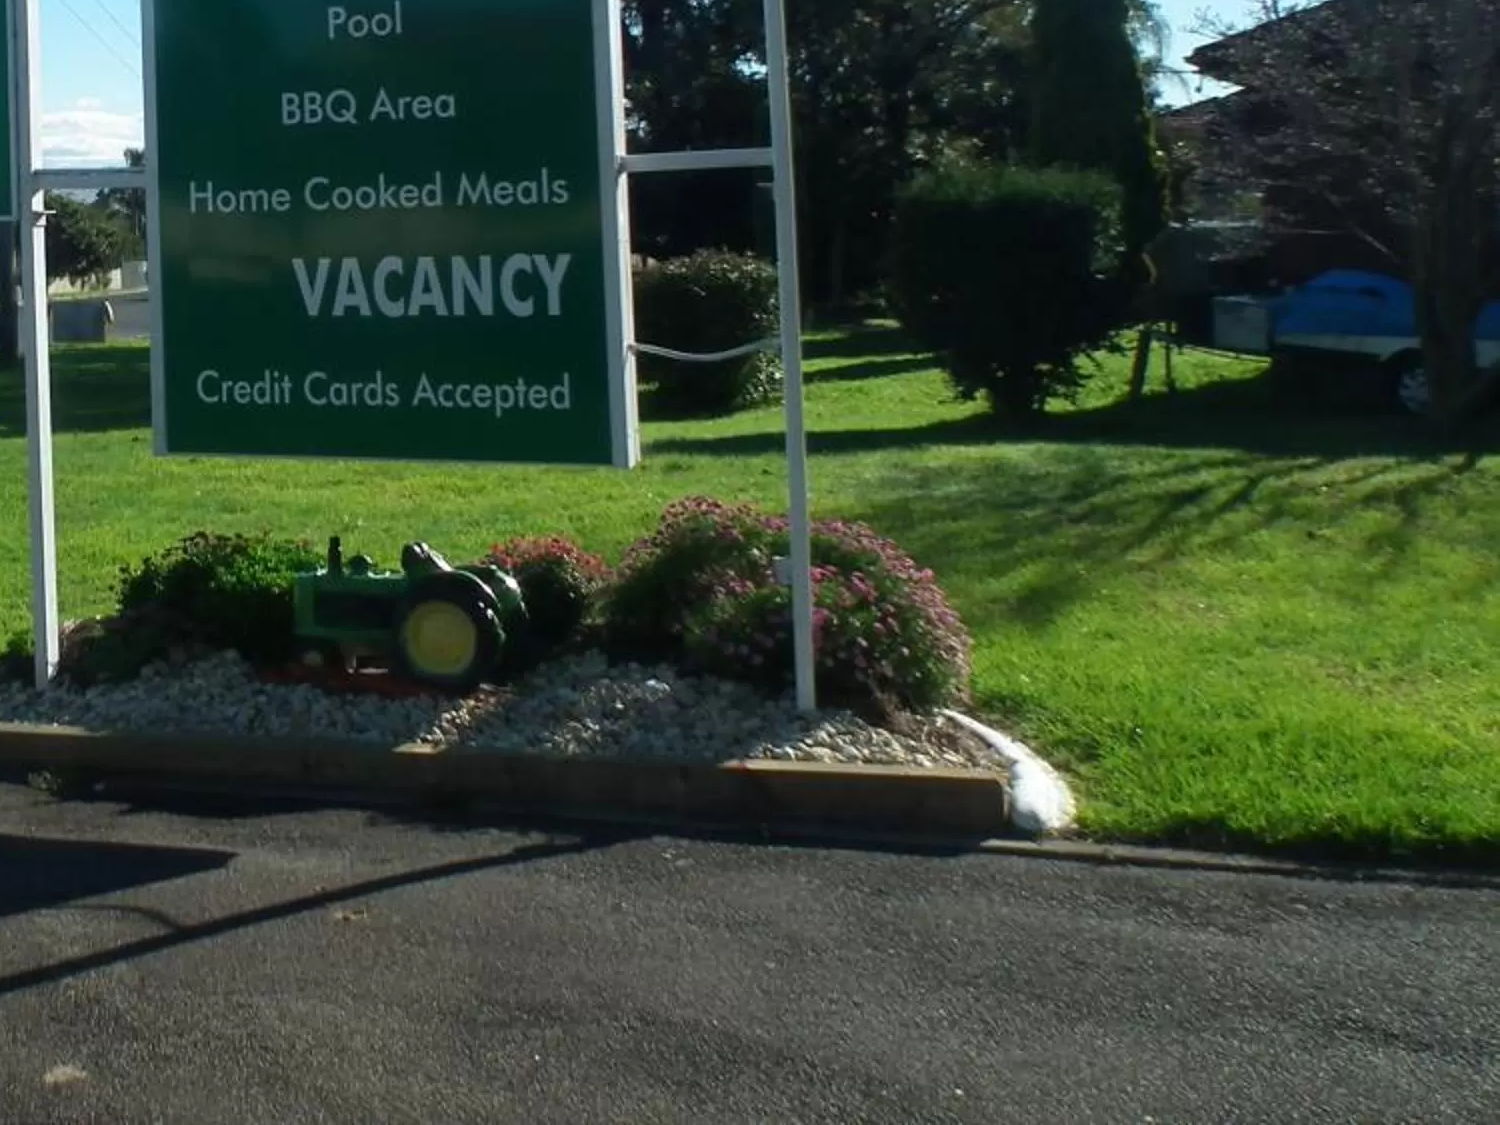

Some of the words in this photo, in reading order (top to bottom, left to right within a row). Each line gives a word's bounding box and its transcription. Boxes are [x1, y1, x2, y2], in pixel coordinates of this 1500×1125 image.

[327, 0, 402, 39] Pool
[281, 88, 357, 124] BBQ
[369, 87, 456, 121] Area
[189, 181, 291, 214] Home
[304, 171, 443, 211] Cooked
[457, 168, 569, 207] Meals
[292, 253, 572, 318] VACANCY
[197, 370, 292, 405] Credit
[304, 370, 400, 406] Cards
[412, 373, 571, 417] Accepted
